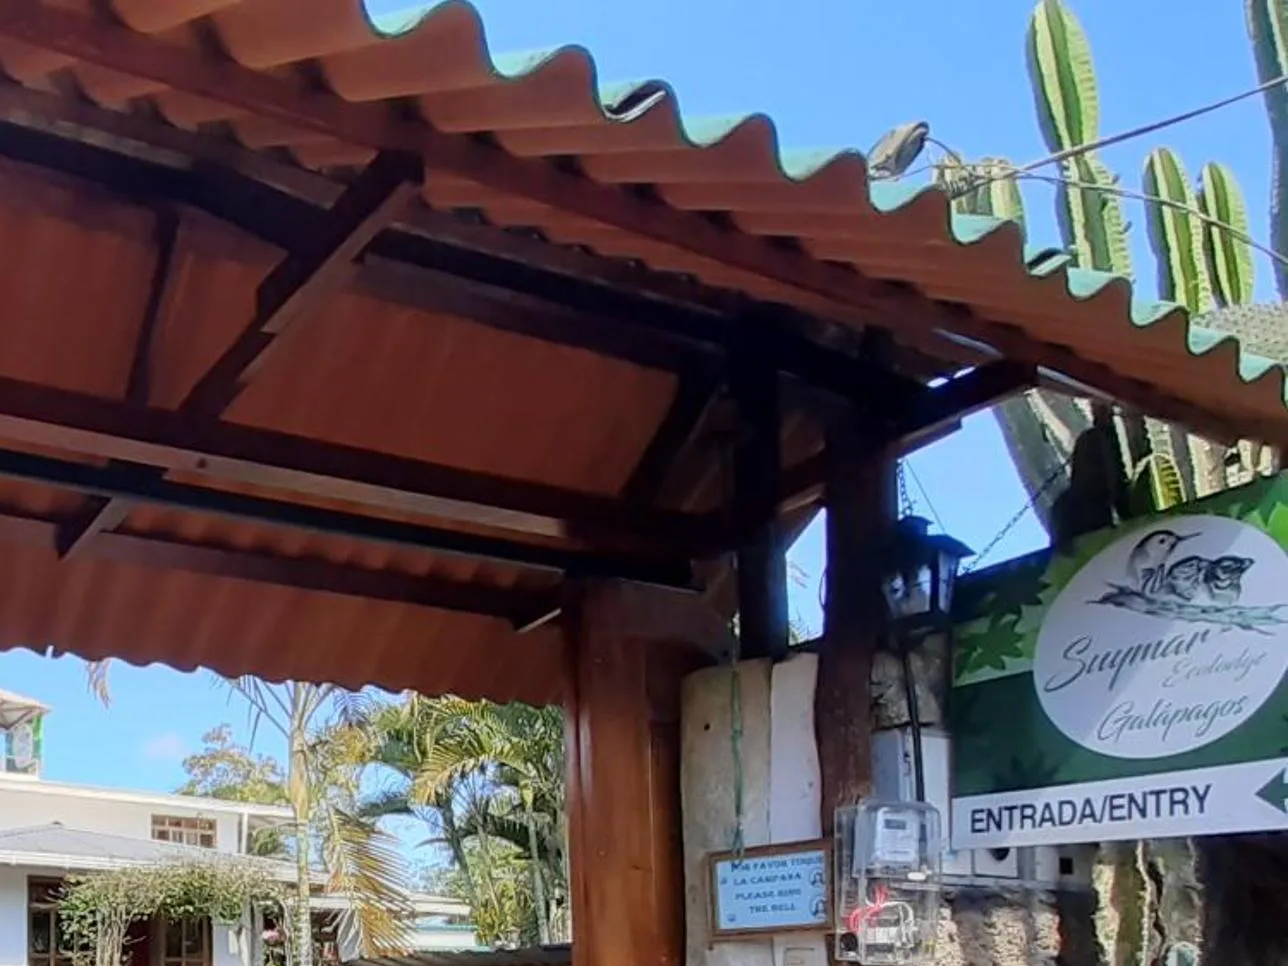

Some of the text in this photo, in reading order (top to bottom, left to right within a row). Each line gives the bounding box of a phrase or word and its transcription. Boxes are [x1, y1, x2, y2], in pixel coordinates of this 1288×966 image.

[1044, 628, 1212, 692] Suymar
[1098, 697, 1248, 742] Galápagos
[970, 784, 1213, 834] ENTRADA/ENTRY
